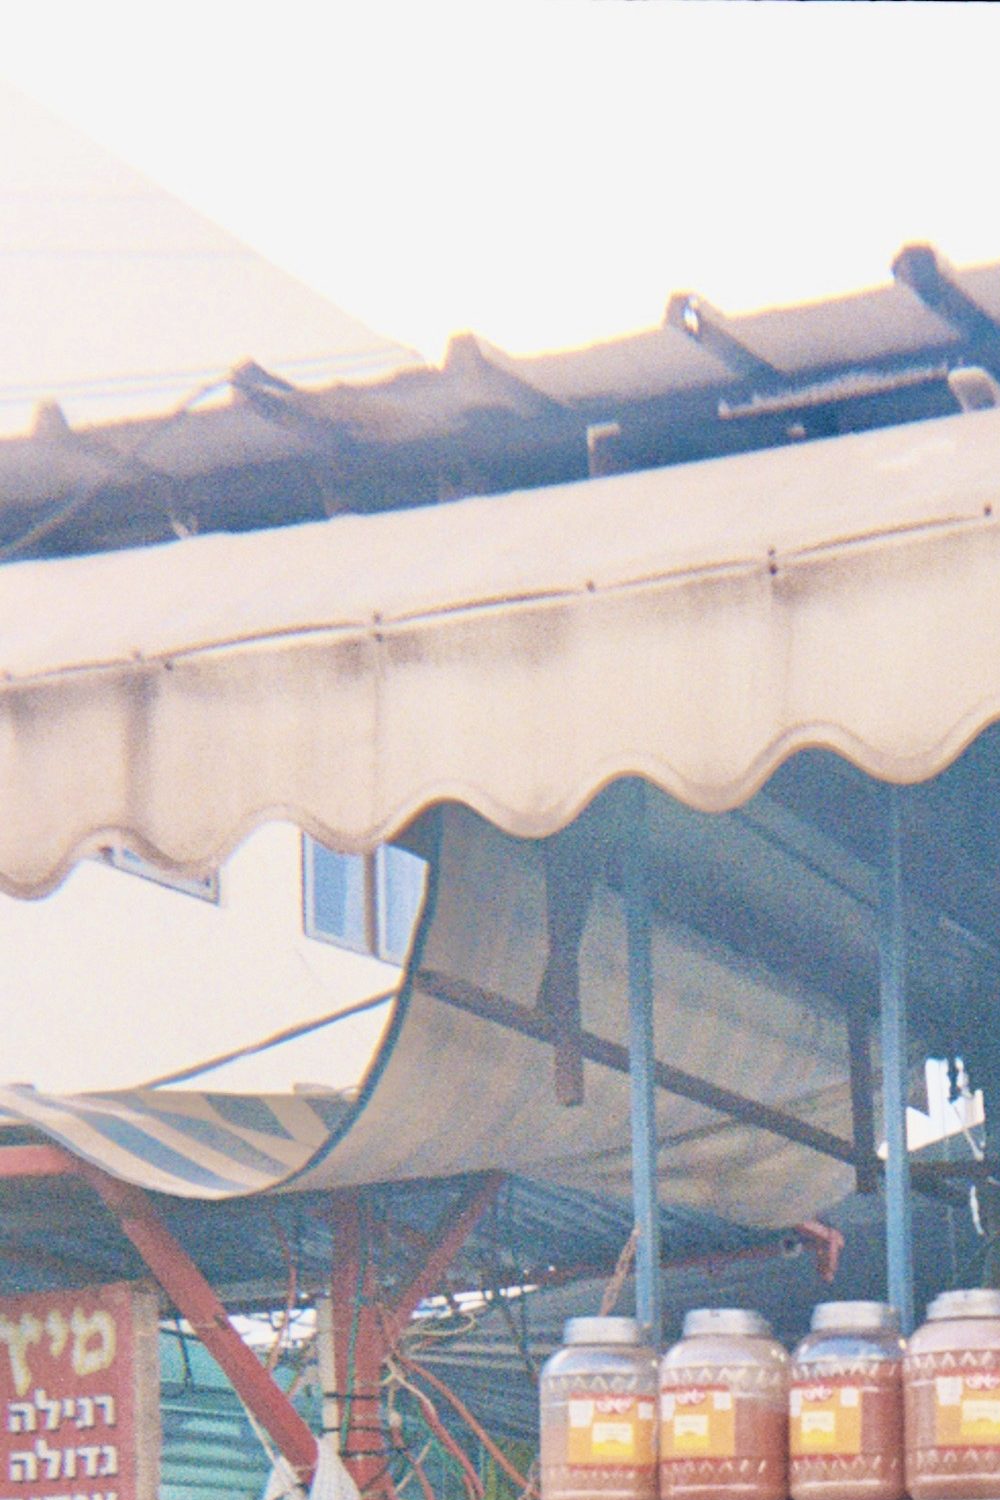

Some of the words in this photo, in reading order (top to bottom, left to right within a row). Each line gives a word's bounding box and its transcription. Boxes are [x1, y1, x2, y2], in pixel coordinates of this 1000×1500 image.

[0, 1306, 117, 1398] מיץ
[7, 1388, 115, 1433] רגילה
[9, 1438, 119, 1482] גדולה
